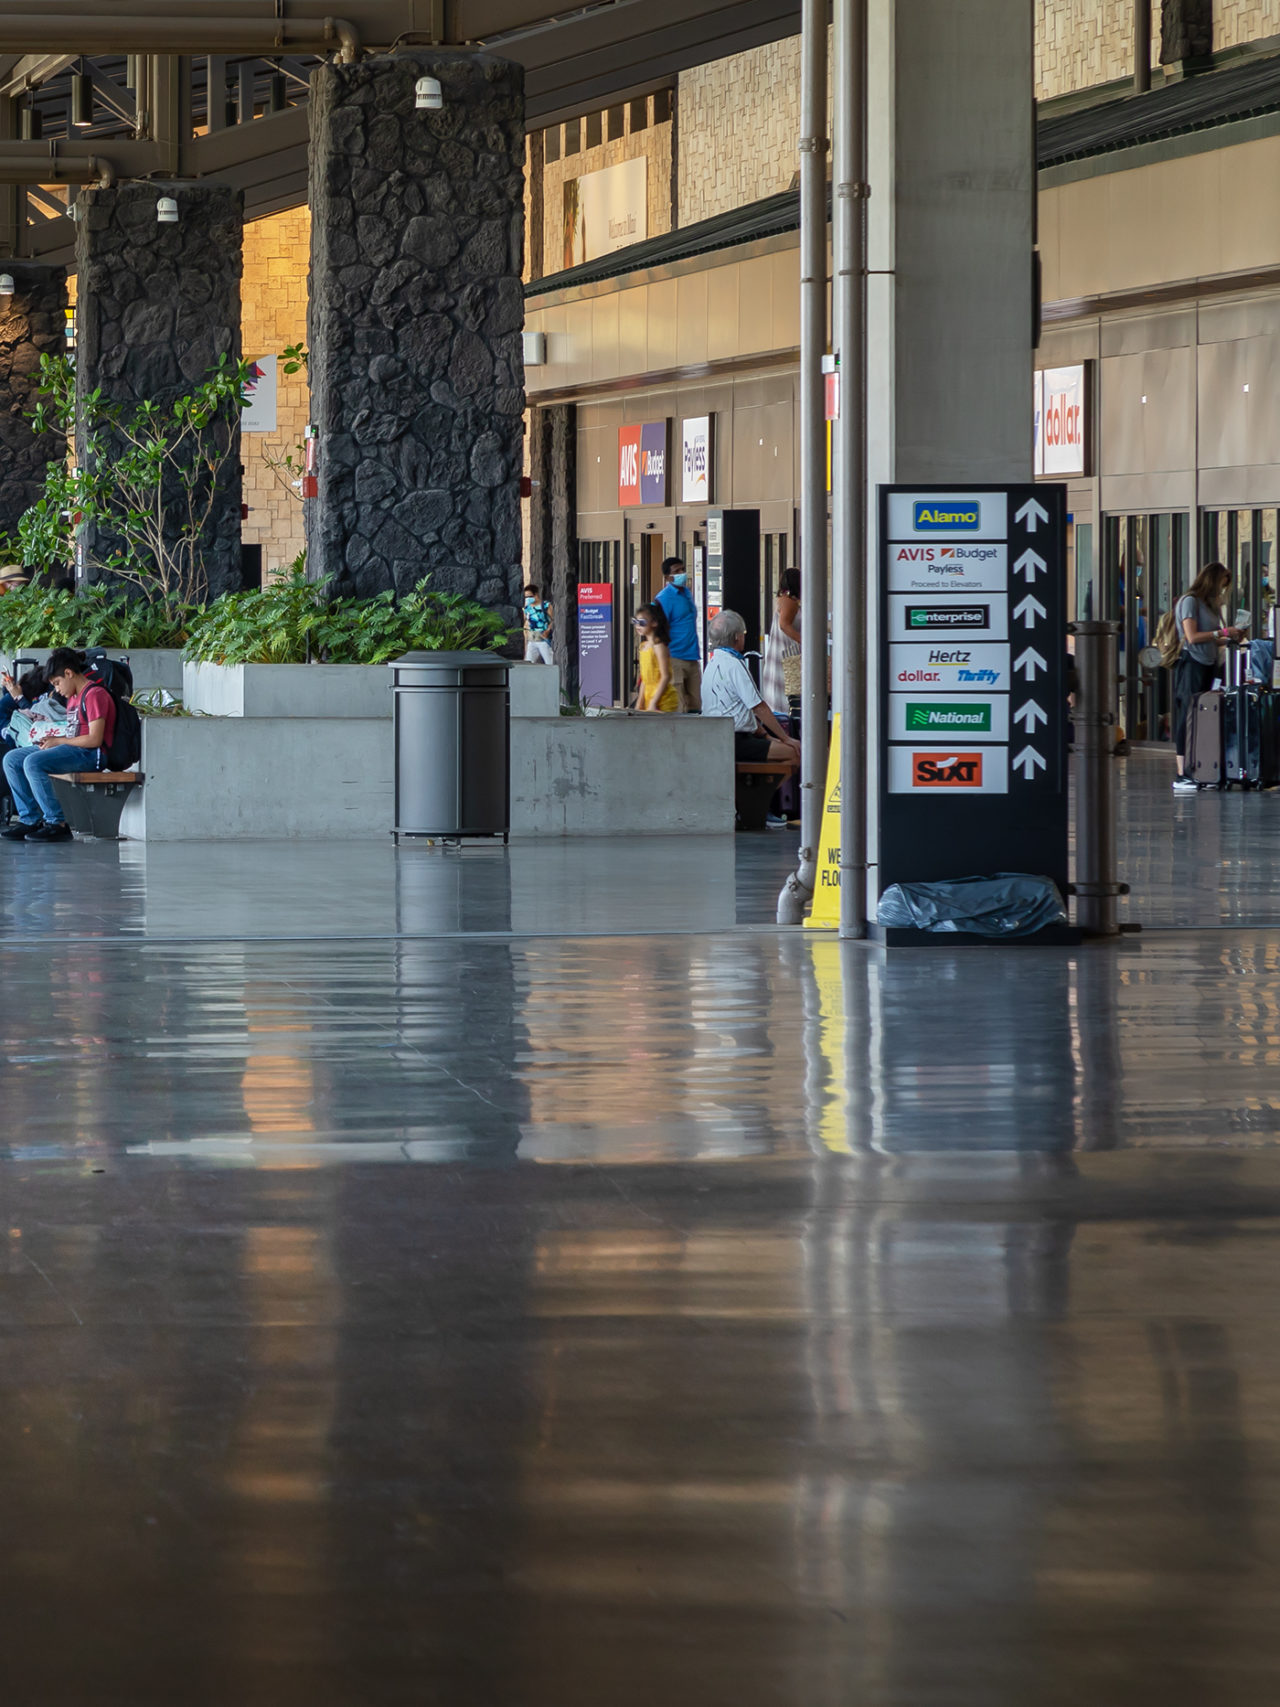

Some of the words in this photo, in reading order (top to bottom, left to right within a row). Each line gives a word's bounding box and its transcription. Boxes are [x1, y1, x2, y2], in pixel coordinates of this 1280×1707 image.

[1046, 392, 1081, 447] dollar.
[620, 443, 638, 487] AVIS
[647, 449, 664, 484] Budget
[684, 438, 706, 482] Payless
[917, 509, 977, 523] Alamo
[896, 548, 936, 561] AVIS
[956, 547, 998, 562] Budget
[928, 563, 965, 575] Payless
[911, 580, 940, 588] Proceed
[950, 580, 983, 588] Elevators
[914, 612, 982, 623] enterprise
[928, 650, 972, 663] Hertz
[897, 669, 942, 682] dollar.
[957, 669, 1001, 685] Thrifty
[928, 711, 985, 724] National
[827, 847, 841, 865] WE
